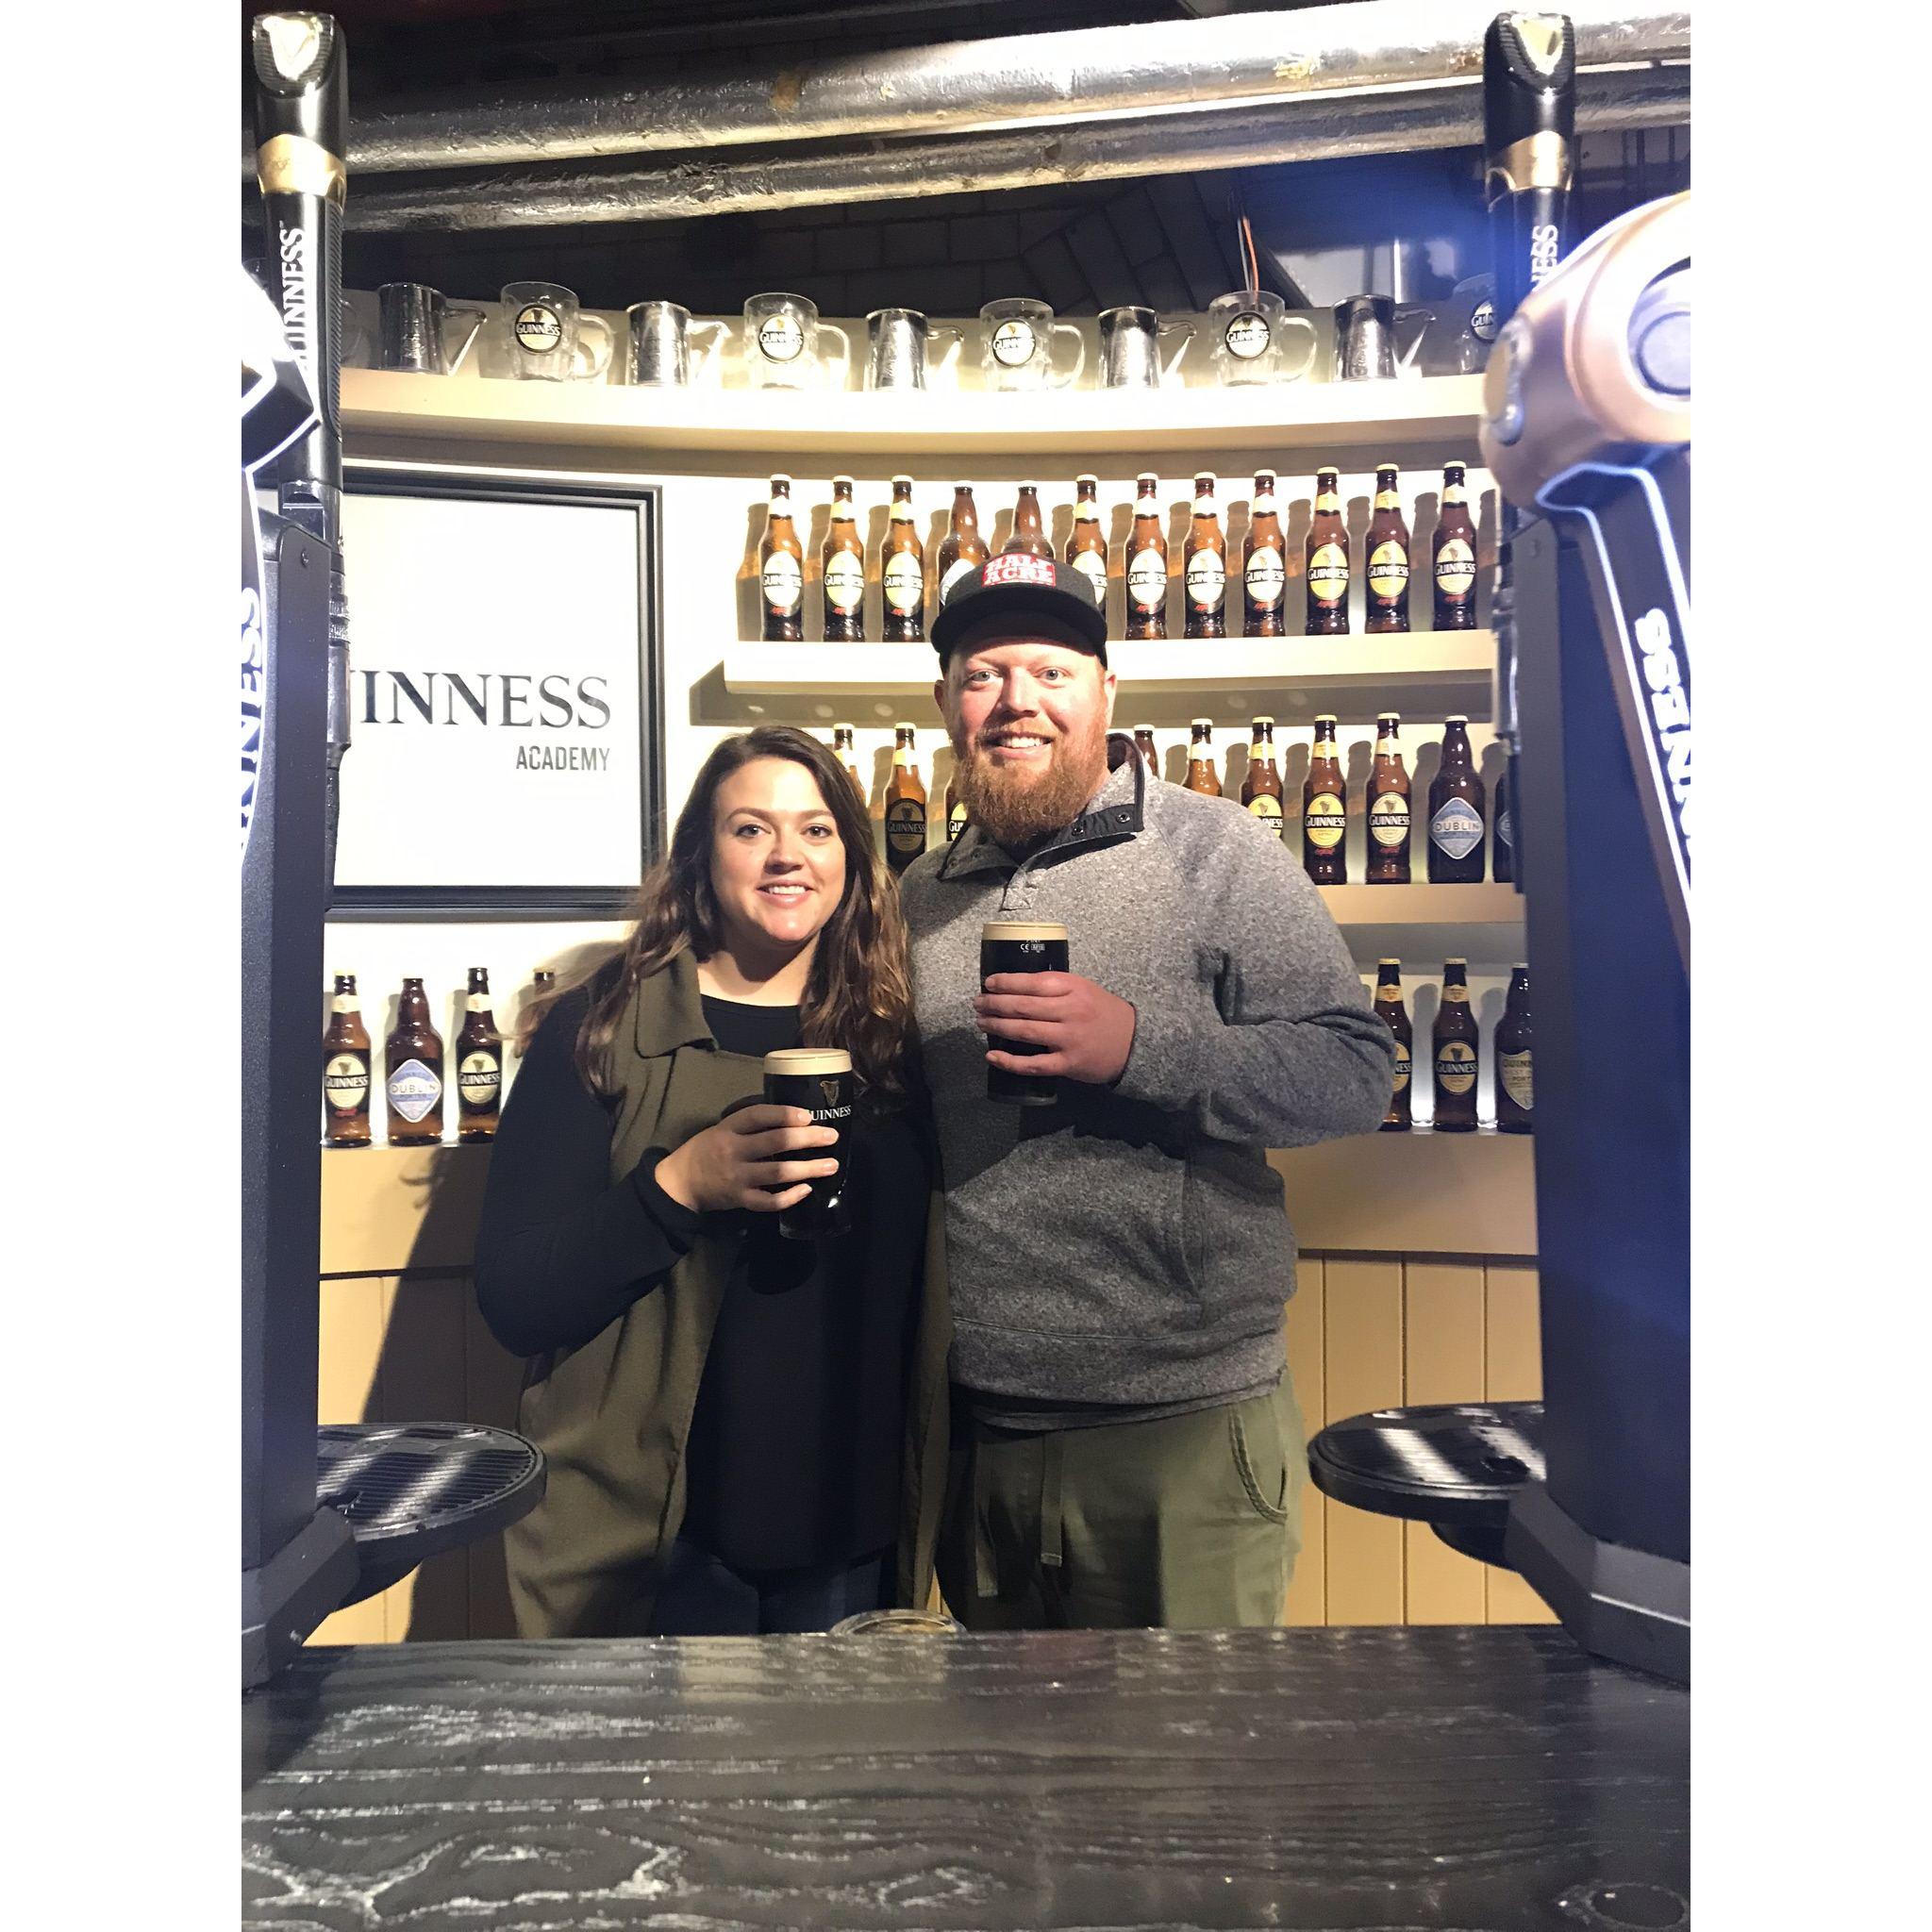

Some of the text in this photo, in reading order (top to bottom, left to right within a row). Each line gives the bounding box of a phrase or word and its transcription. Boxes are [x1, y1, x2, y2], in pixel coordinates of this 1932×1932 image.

[1530, 225, 1558, 283] ESS
[279, 227, 307, 368] UINNESS
[516, 322, 561, 337] GUINNESS
[759, 332, 804, 346] GUINNSS
[1226, 331, 1270, 343] GUINNSS
[992, 338, 1035, 350] GUINNS
[984, 567, 1054, 584] ACRE
[1367, 566, 1409, 577] GUINNESS
[1435, 563, 1476, 575] GUINNESS
[763, 575, 802, 588] GUINESS
[824, 575, 864, 589] GUINESS
[883, 575, 924, 590] GUINESS
[1127, 573, 1167, 585] GUINESS
[1186, 572, 1225, 585] GUINESS
[350, 670, 611, 729] INNESS
[516, 745, 610, 772] ACADEMY
[1305, 815, 1346, 827] GUINNESS
[1369, 814, 1410, 826] GUINNESS
[1435, 822, 1479, 831] DUBLIN
[888, 821, 925, 833] GUINNESS
[1435, 1060, 1478, 1074] GUINNESS
[324, 1074, 369, 1089] GUINNESS
[459, 1072, 501, 1085] GUINNESS
[809, 1105, 852, 1121] UINNESS
